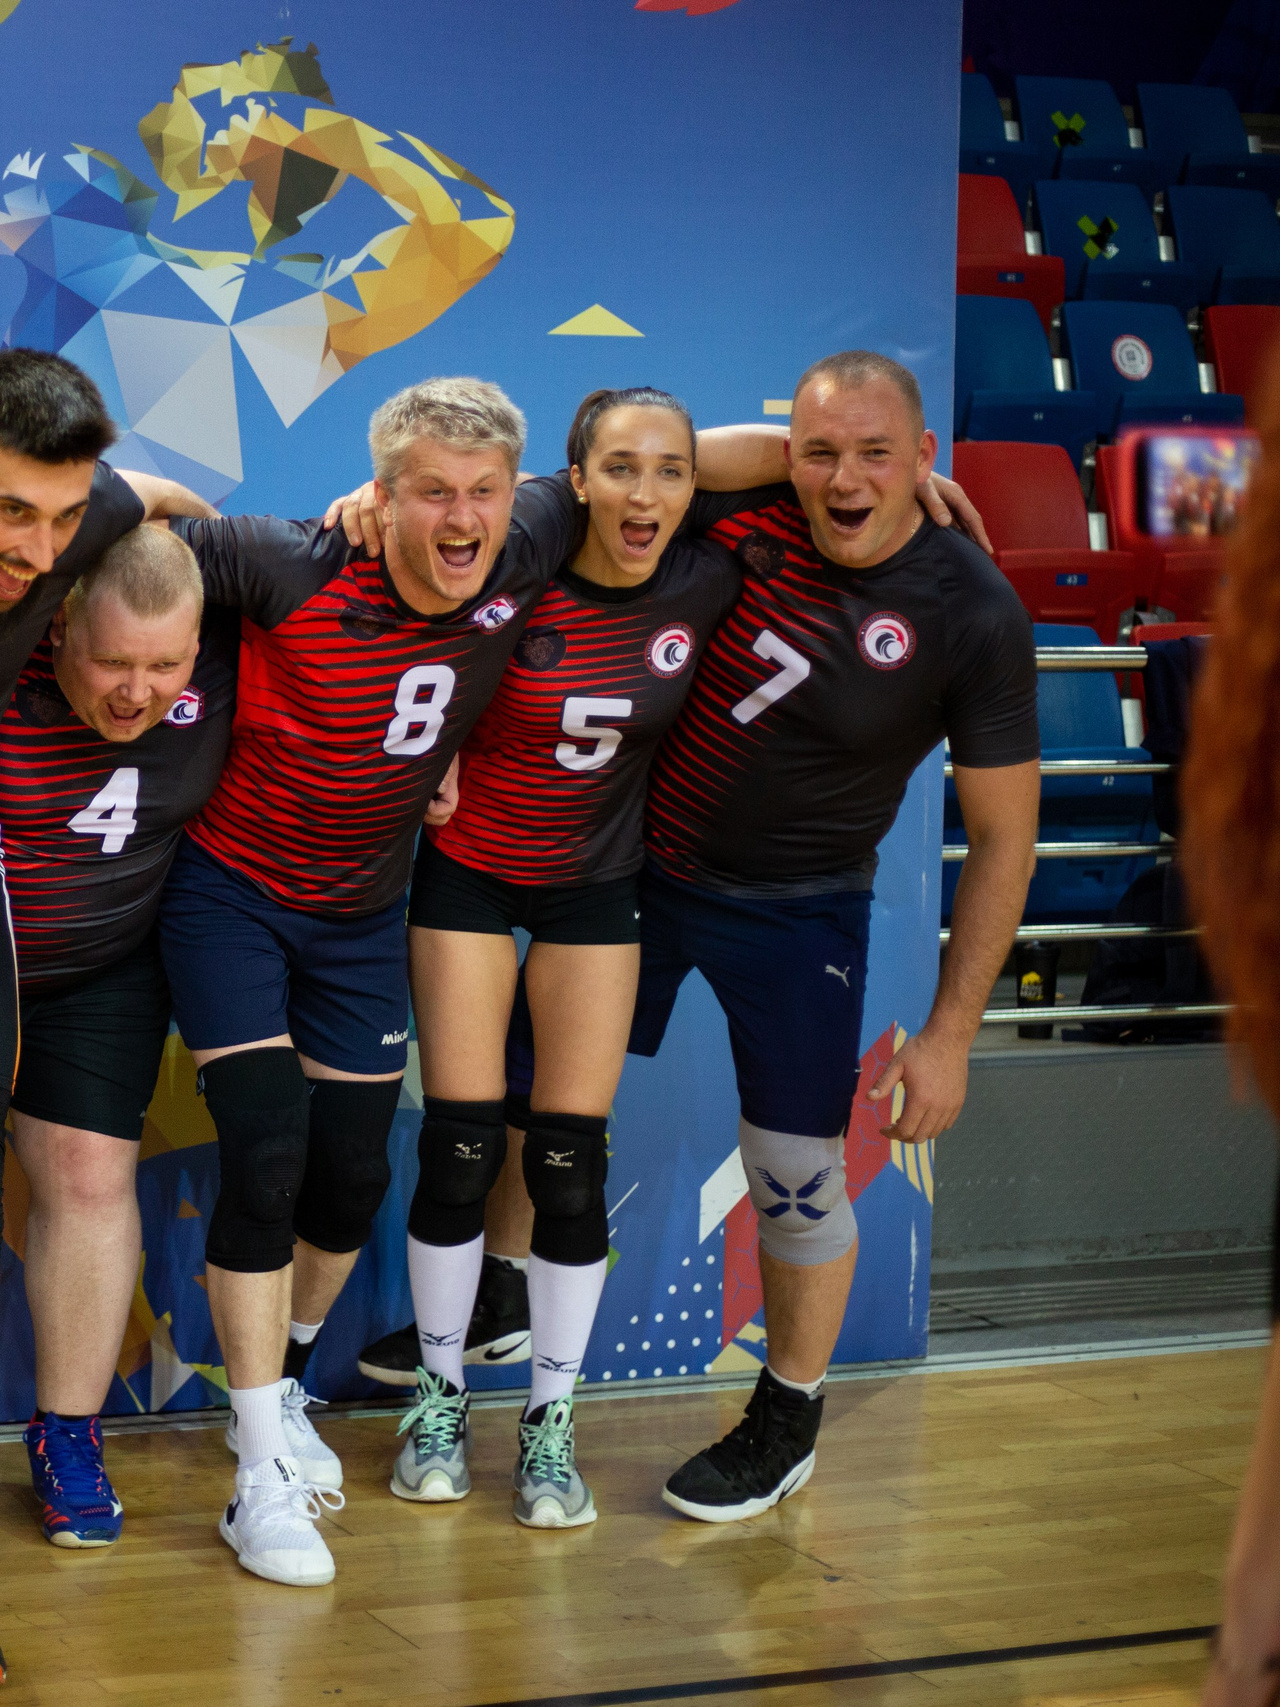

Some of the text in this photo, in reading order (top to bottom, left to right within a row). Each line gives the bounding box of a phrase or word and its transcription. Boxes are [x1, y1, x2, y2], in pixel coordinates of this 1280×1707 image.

[383, 665, 456, 756] 8
[732, 630, 810, 724] 7
[556, 697, 632, 771] 5
[67, 768, 139, 853] 4
